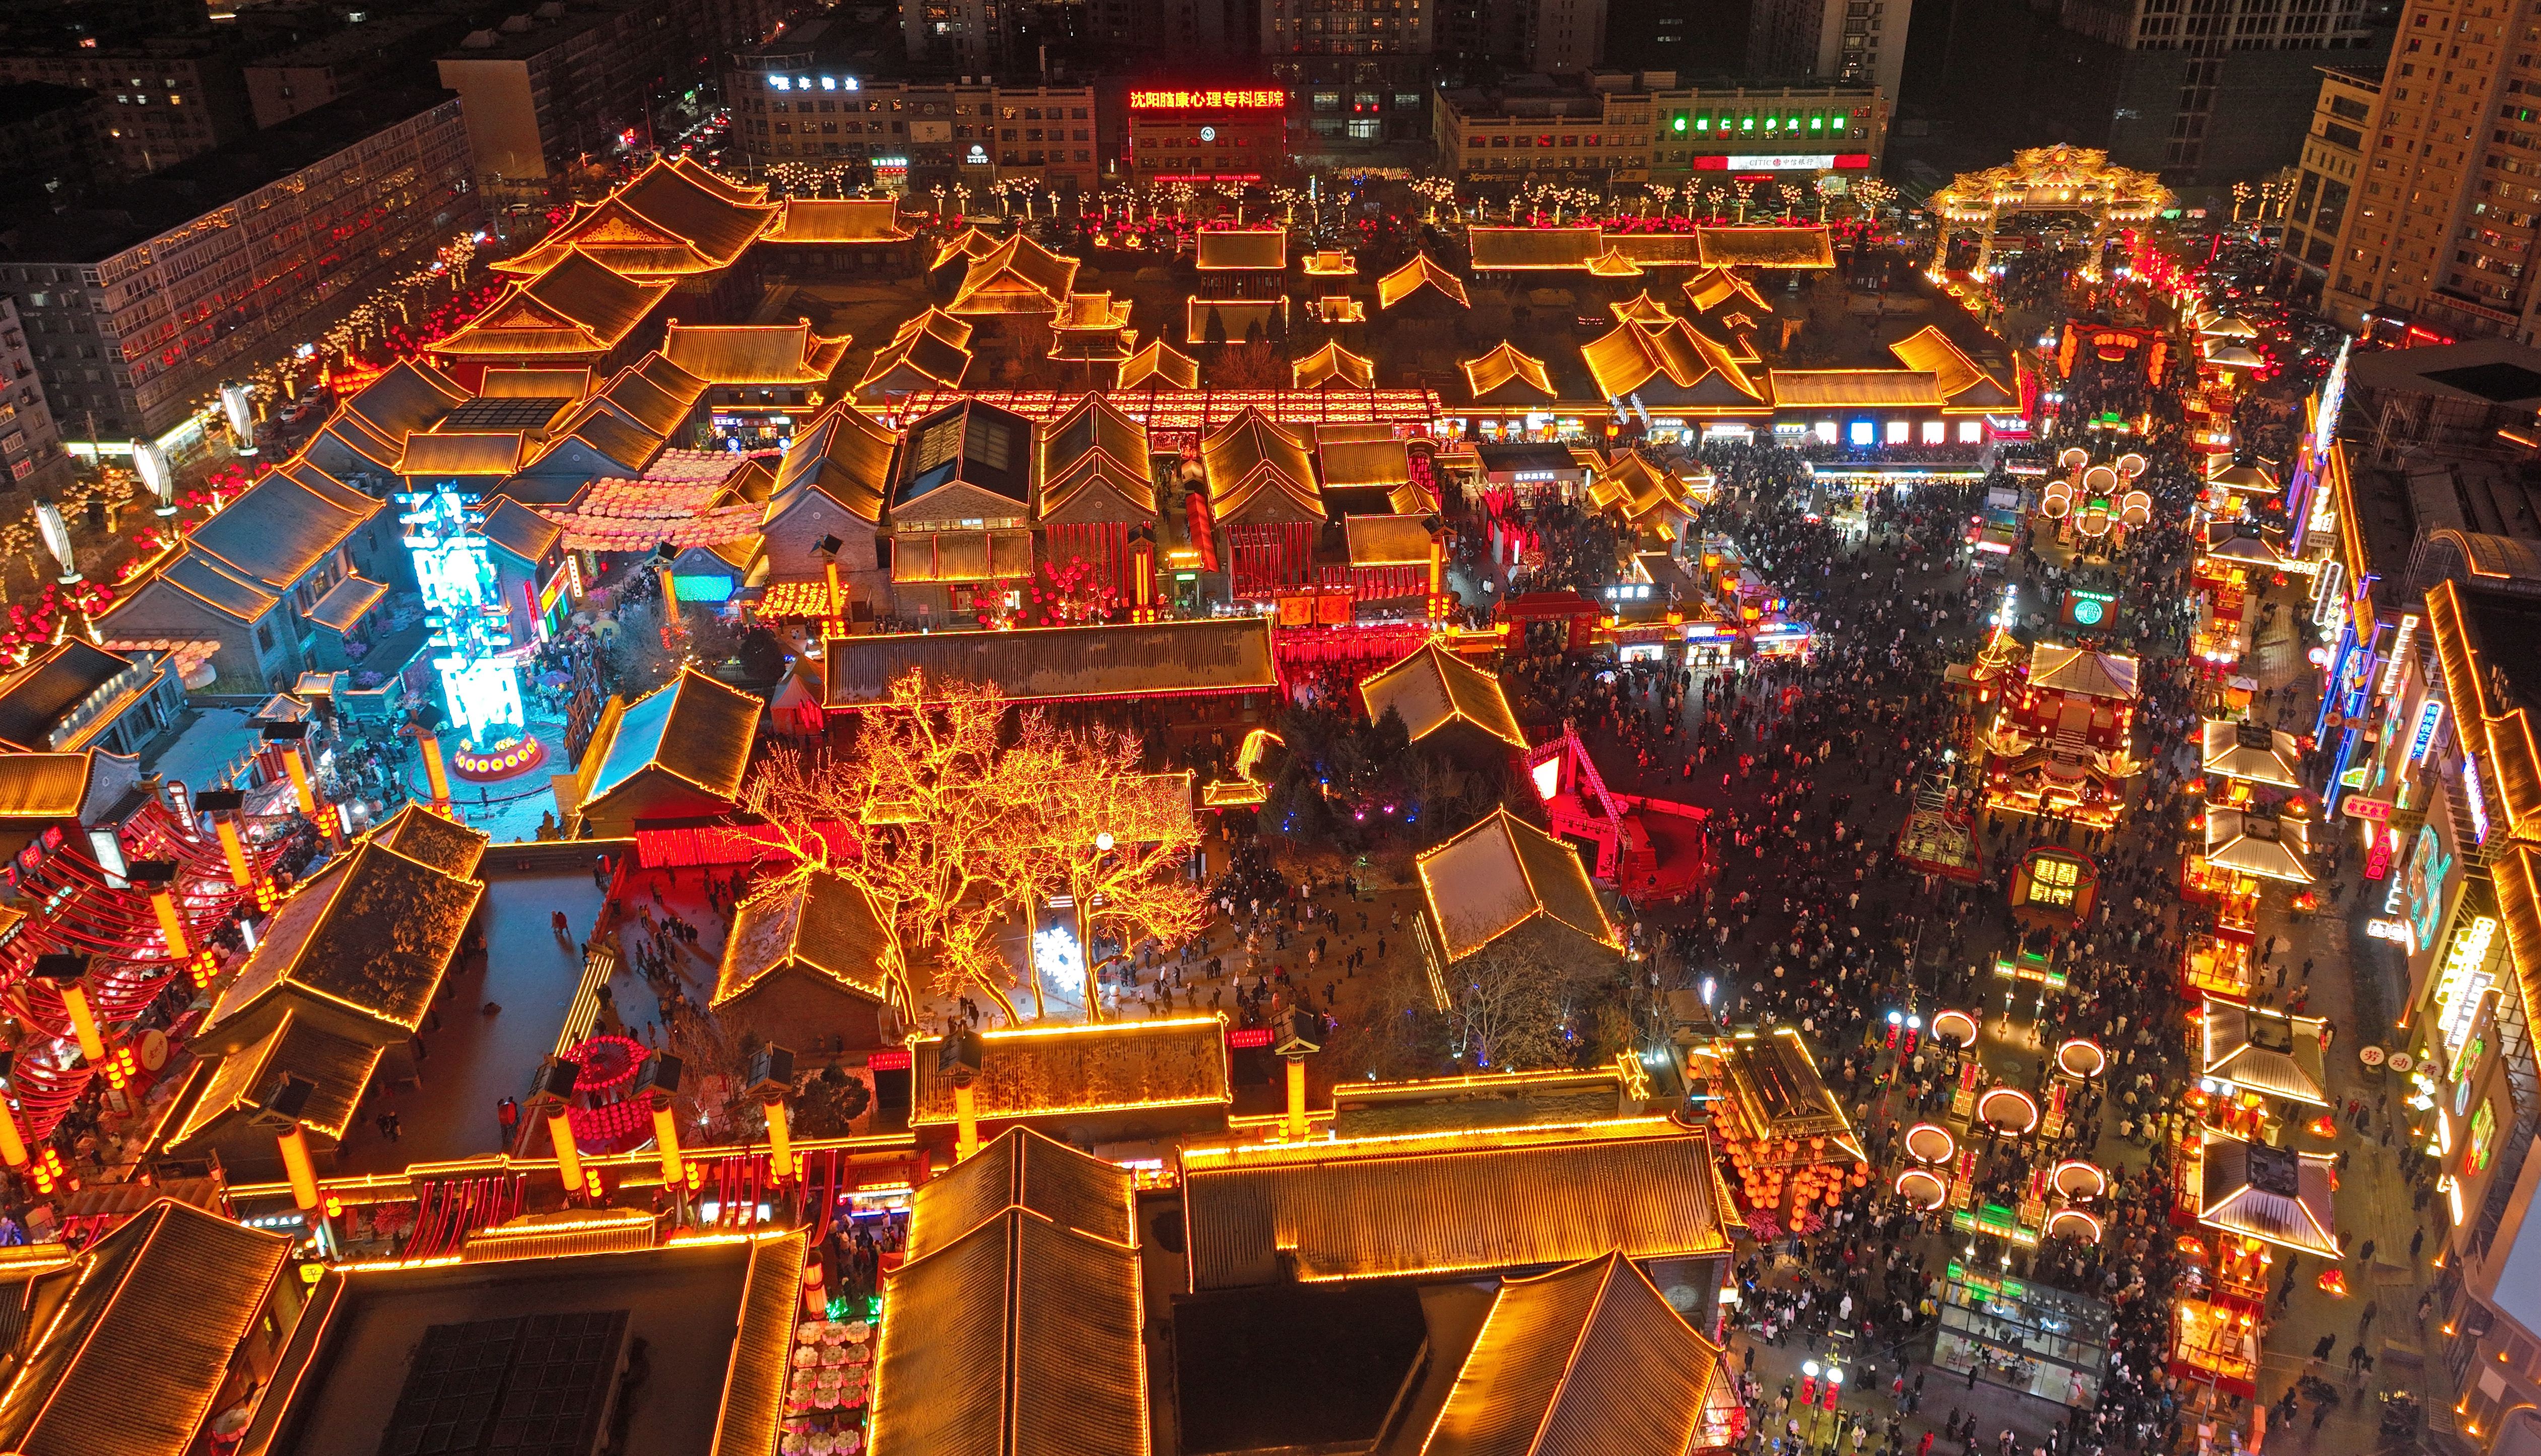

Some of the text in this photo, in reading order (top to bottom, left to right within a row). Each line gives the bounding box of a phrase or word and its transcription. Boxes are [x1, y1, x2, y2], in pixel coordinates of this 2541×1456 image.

[1130, 91, 1284, 108] 沈阳脑康心理专科医院
[2365, 1050, 2437, 1076] 劳动者
